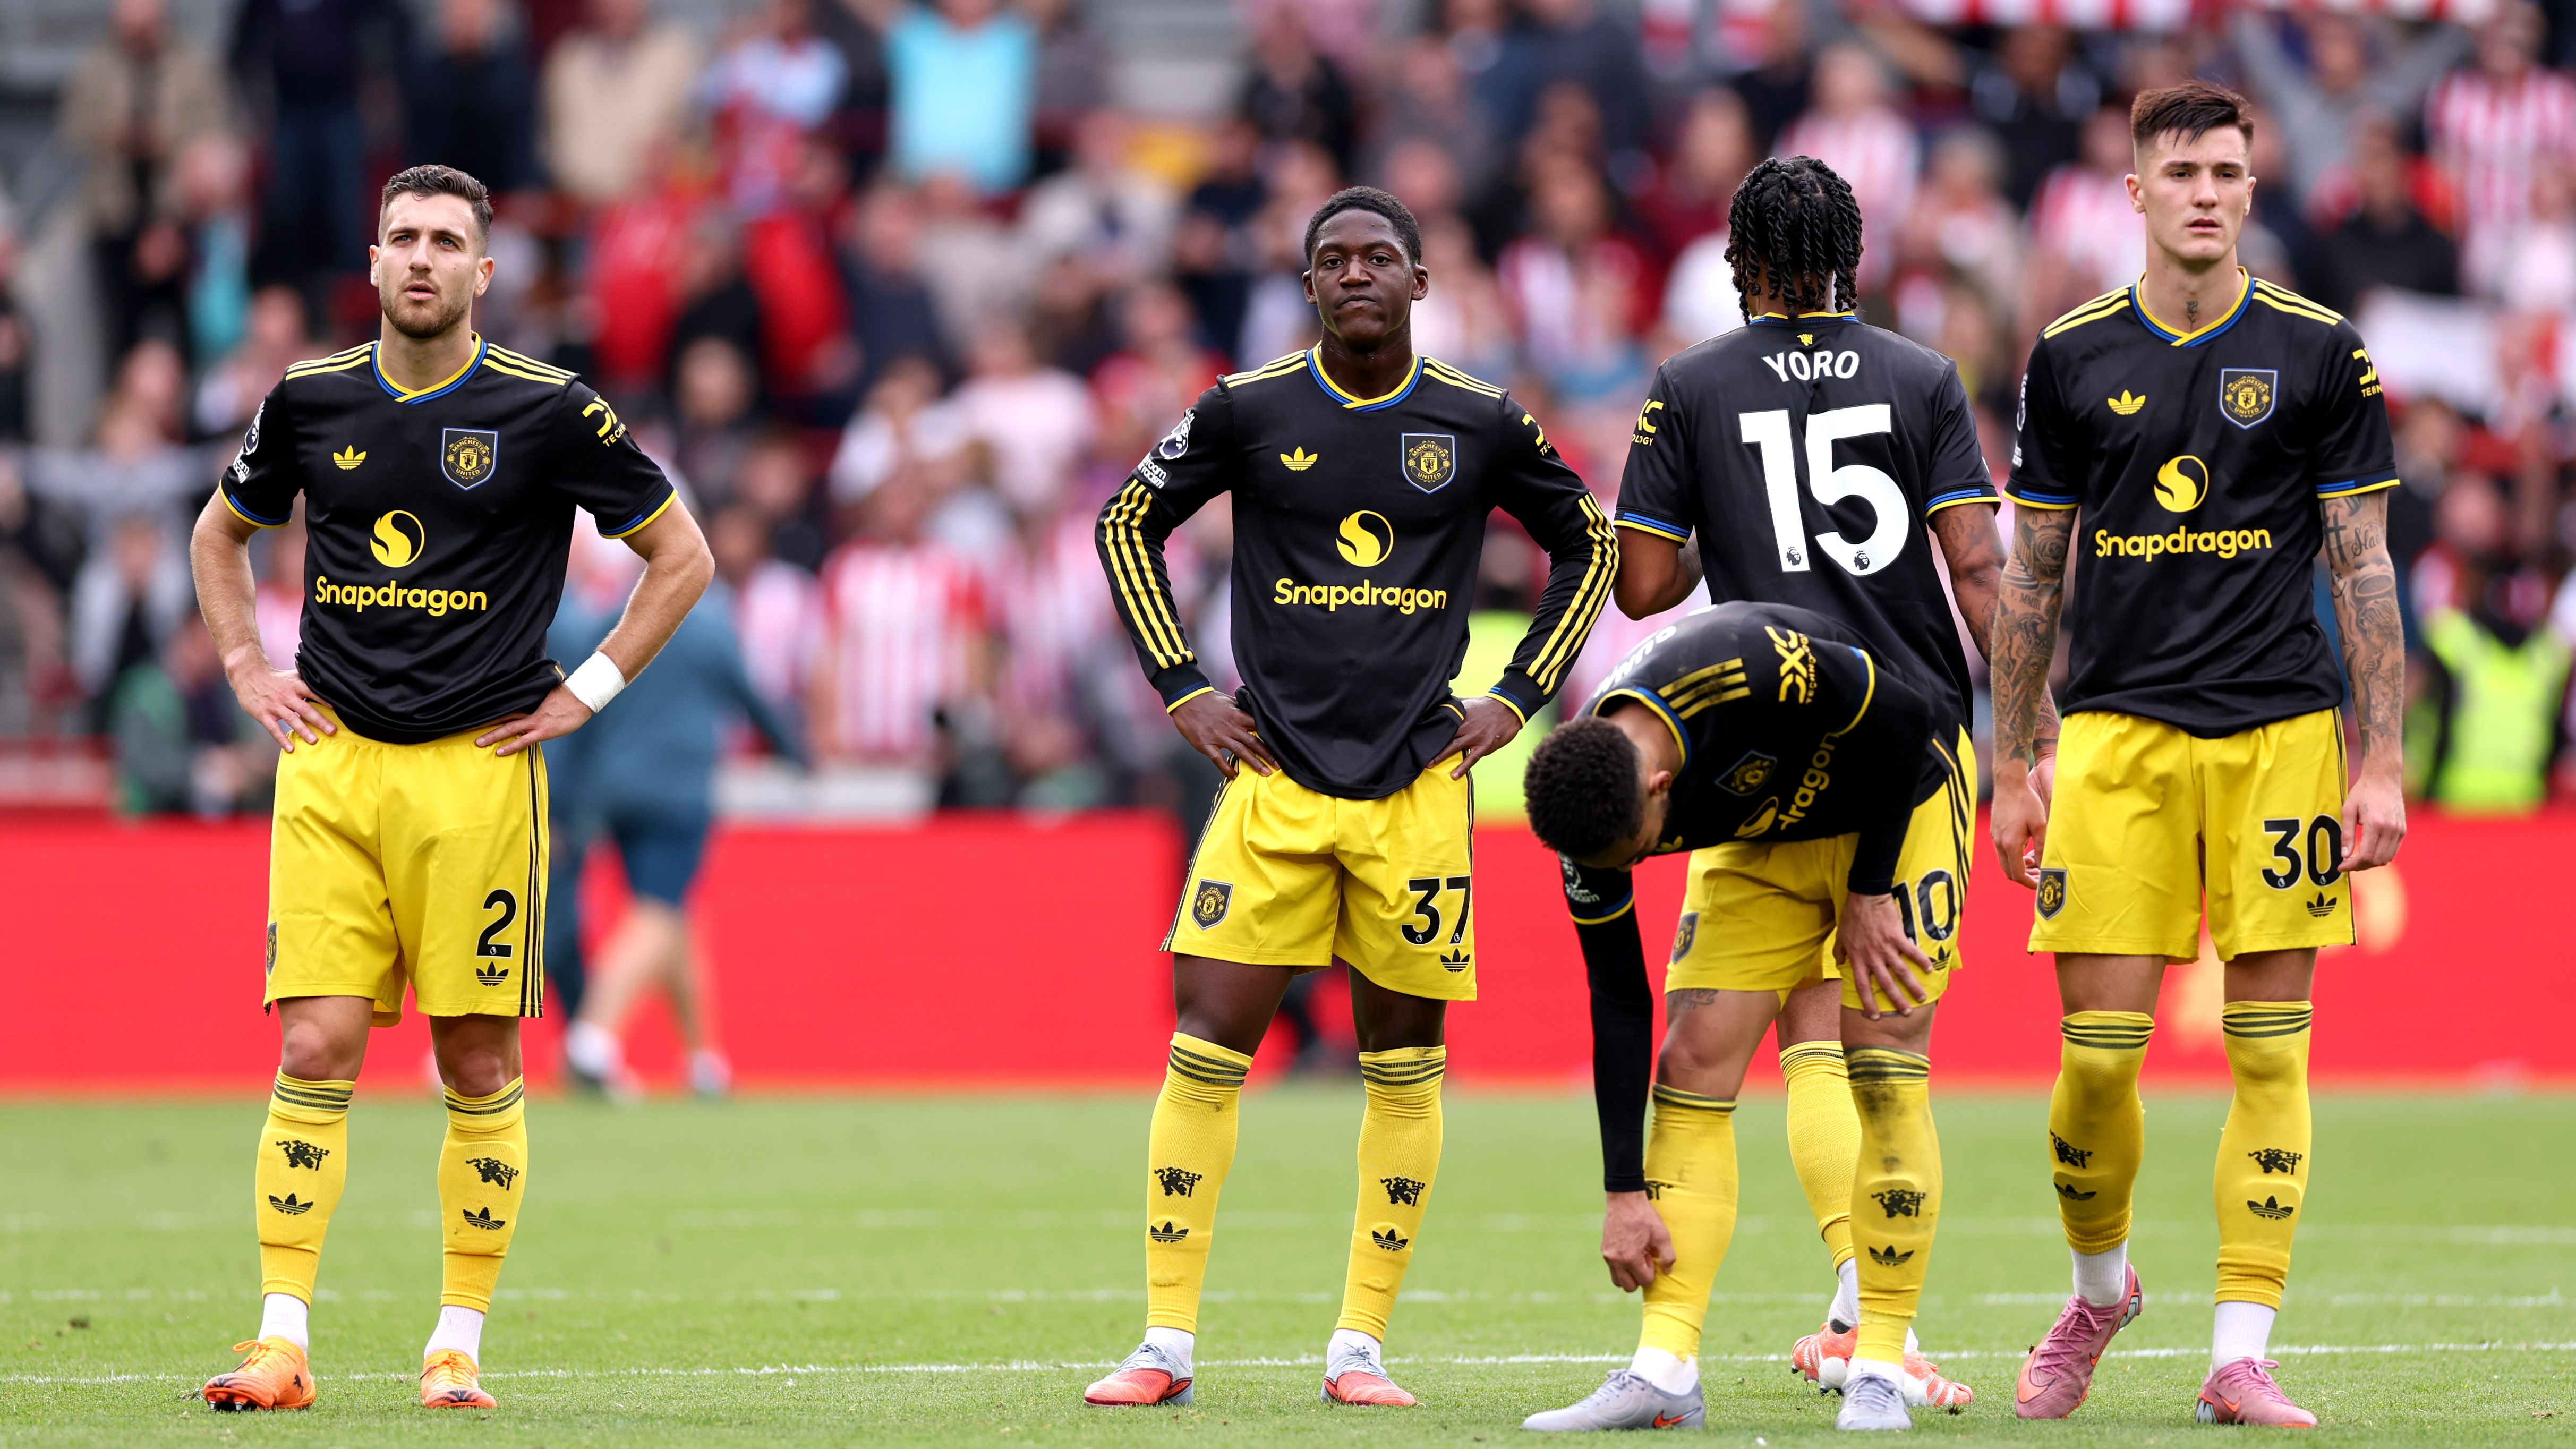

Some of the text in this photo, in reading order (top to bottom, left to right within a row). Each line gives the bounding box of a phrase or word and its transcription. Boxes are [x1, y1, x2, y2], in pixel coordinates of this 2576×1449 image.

[1761, 350, 1860, 382] YORO
[452, 439, 486, 455] MANCHESTER
[1412, 444, 1446, 457] MANCHESTER
[1146, 458, 1167, 480] room
[1738, 403, 1910, 577] 15
[2095, 525, 2272, 562] Snapdragon
[315, 575, 487, 617] Snapdragon
[1274, 578, 1447, 615] Snapdragon
[1764, 626, 1808, 704] DXC
[2261, 814, 2343, 890] 30
[476, 888, 517, 958] 2
[1401, 875, 1471, 945] 37
[1891, 868, 1957, 945] 10
